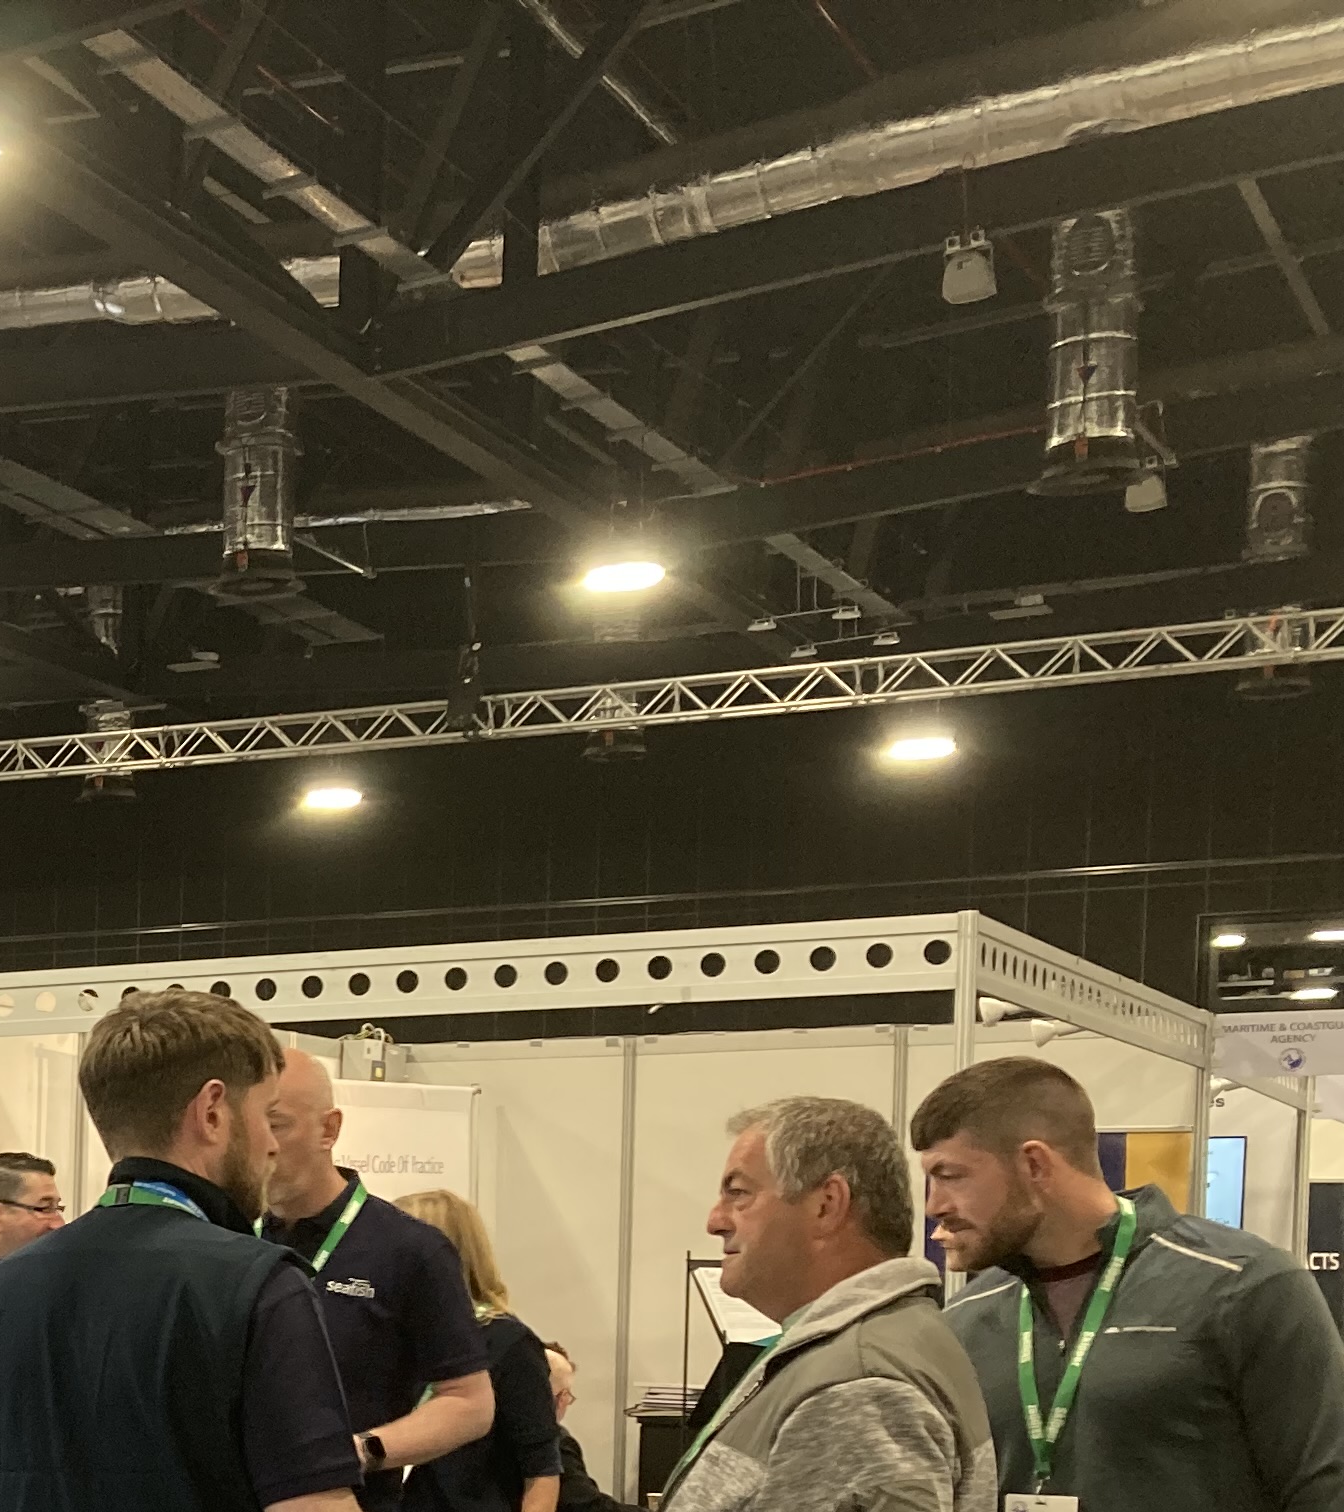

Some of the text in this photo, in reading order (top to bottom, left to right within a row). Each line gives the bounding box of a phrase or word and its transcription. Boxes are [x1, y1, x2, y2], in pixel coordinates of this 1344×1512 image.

[1223, 1024, 1276, 1033] MARITIME
[1279, 1023, 1286, 1031] &
[1271, 1034, 1316, 1043] AGENCY
[372, 1154, 395, 1174] Code
[398, 1154, 409, 1174] Of
[1305, 1253, 1340, 1271] CTS
